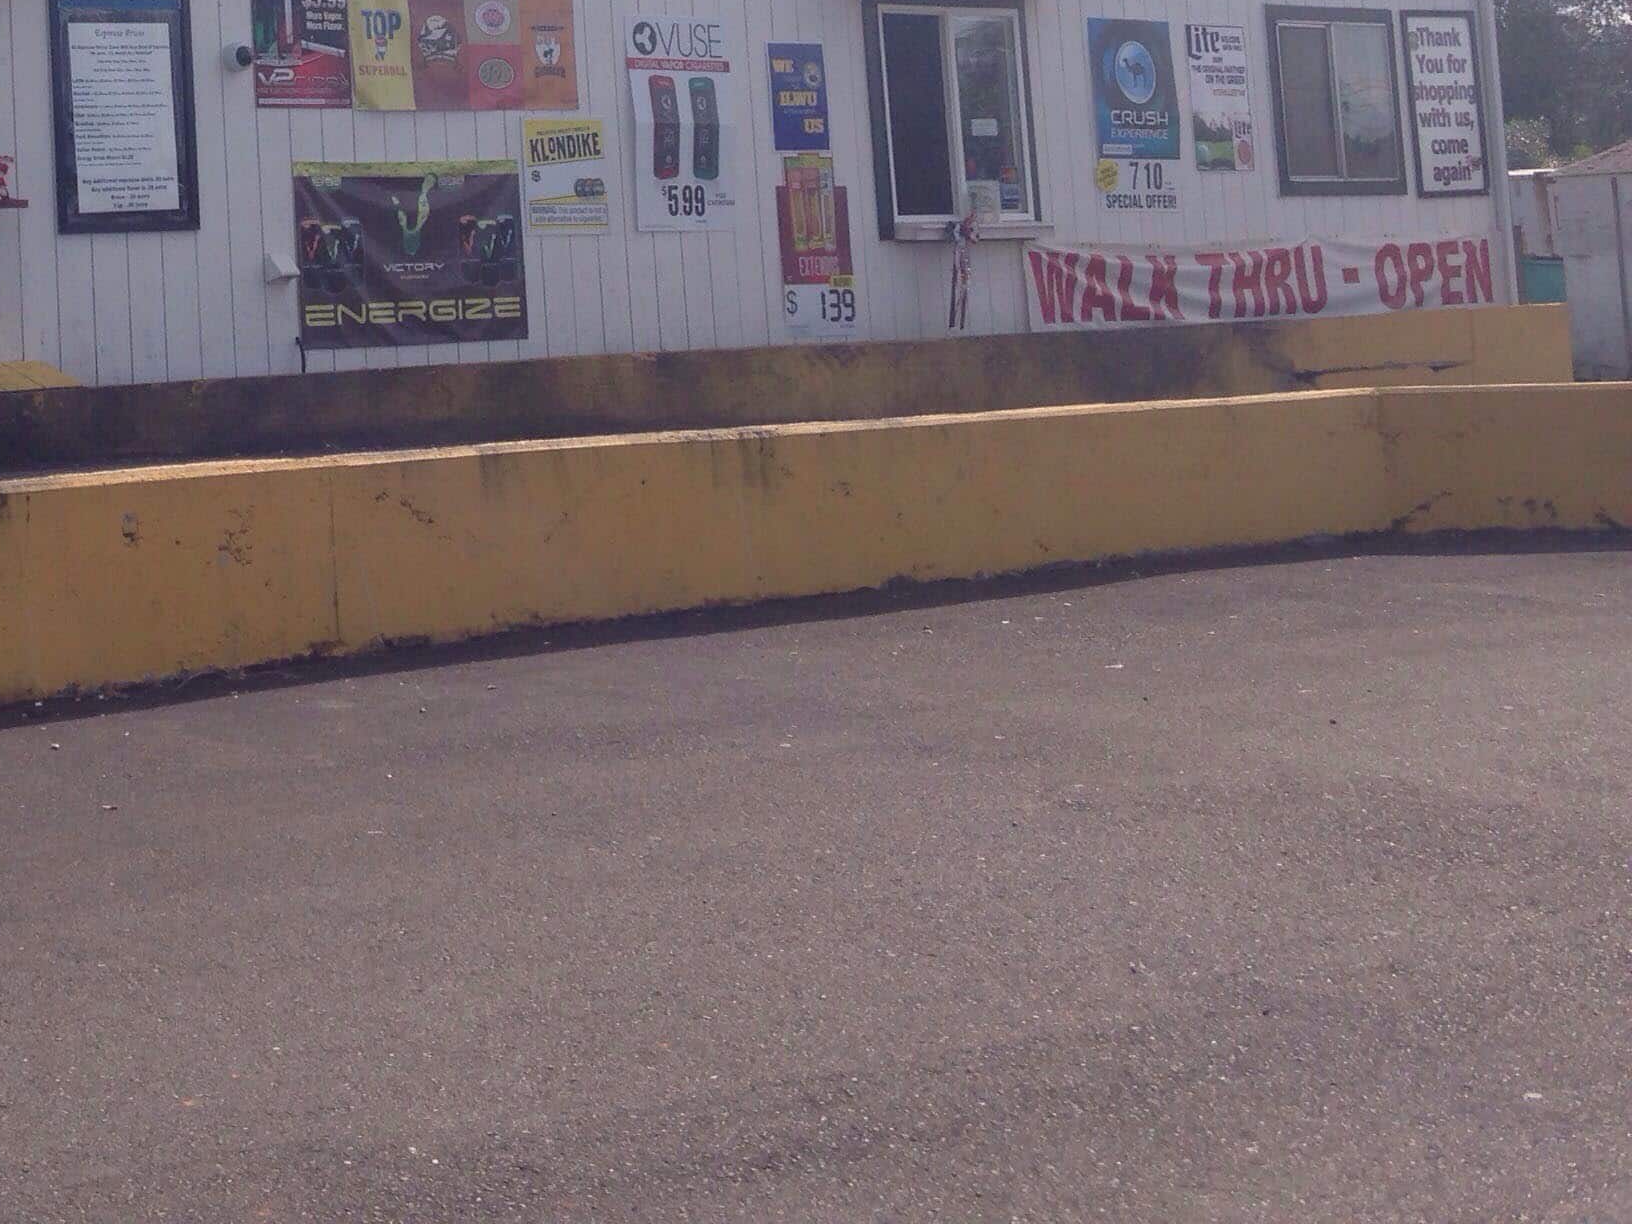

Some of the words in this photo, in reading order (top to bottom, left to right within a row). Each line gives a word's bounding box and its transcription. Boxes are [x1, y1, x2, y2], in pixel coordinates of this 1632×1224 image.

[361, 9, 402, 40] TOP
[655, 22, 723, 58] VUSE
[1185, 24, 1221, 60] Lite
[1416, 27, 1461, 48] Thank
[1417, 54, 1444, 74] You
[1446, 53, 1467, 74] for
[1413, 82, 1476, 105] shopping
[1111, 110, 1169, 125] CRUSH
[1419, 109, 1452, 128] with
[1455, 111, 1475, 132] us,
[1111, 128, 1169, 140] EXPERIENCE
[1431, 136, 1469, 155] come
[529, 130, 601, 164] KLONDIKE
[531, 169, 541, 183] $
[1106, 193, 1144, 210] SPECIAL
[1145, 193, 1177, 210] OFFER!
[383, 261, 445, 274] VICTORY
[1028, 251, 1186, 324] WALK
[1195, 244, 1328, 319] THRU
[1374, 238, 1494, 310] OPEN
[304, 295, 521, 327] ENERGIZE
[786, 289, 798, 316] $
